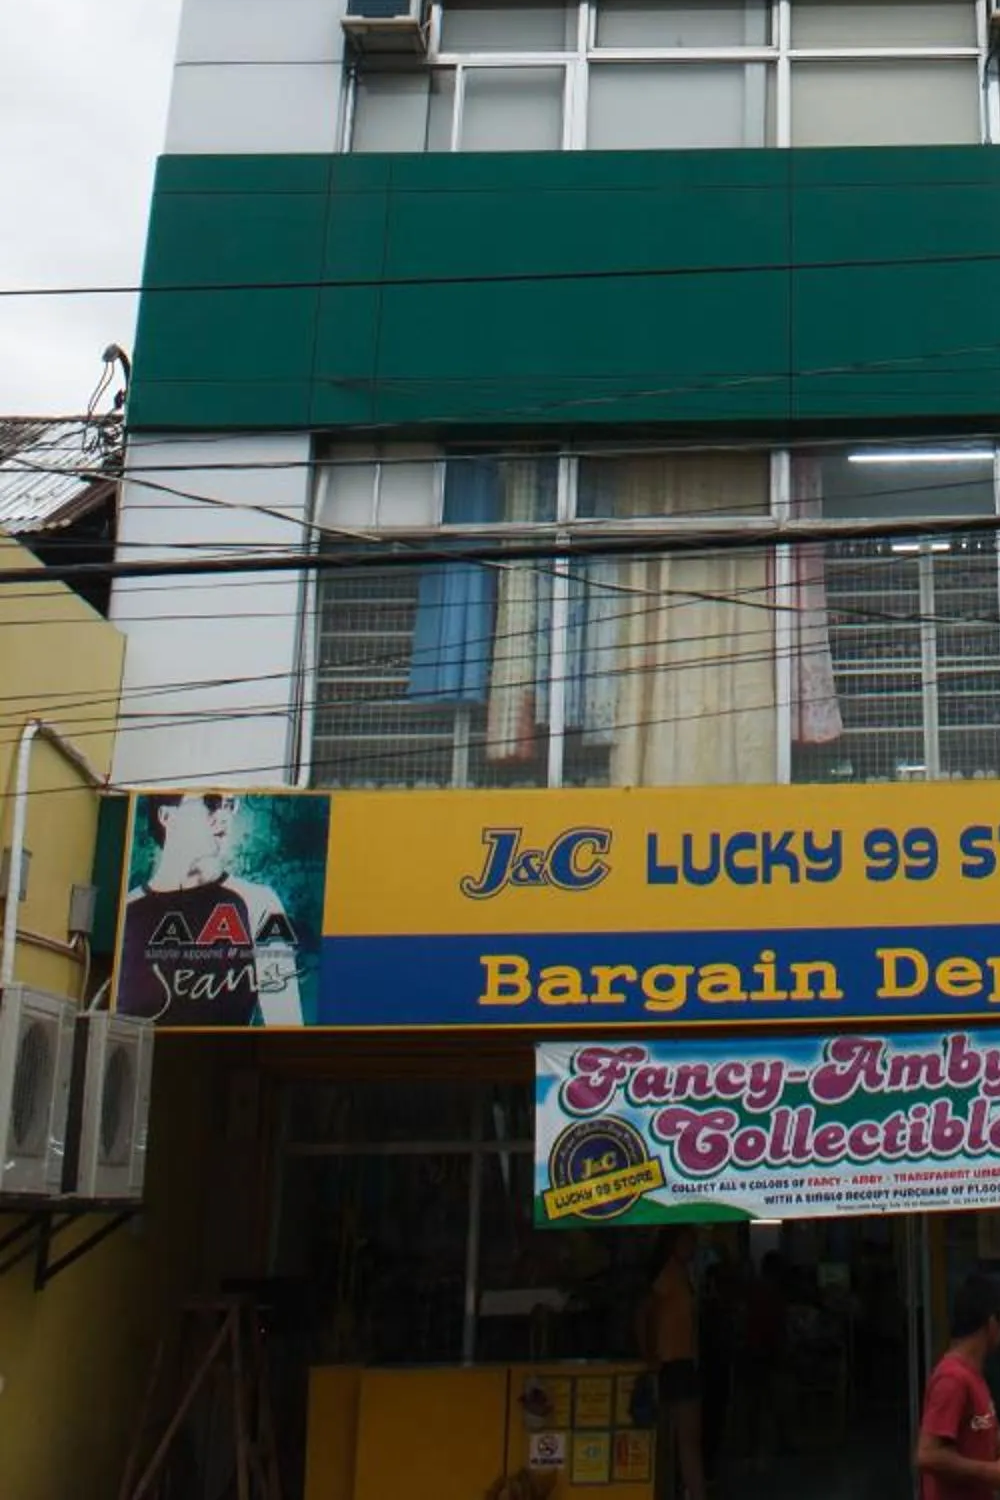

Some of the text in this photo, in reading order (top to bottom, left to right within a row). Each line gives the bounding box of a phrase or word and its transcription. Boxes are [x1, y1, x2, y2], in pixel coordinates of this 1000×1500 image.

[460, 827, 613, 899] J&C
[647, 831, 843, 885] LUCKY
[863, 828, 939, 881] 99
[148, 903, 298, 945] AAA
[478, 950, 843, 1011] Bargain
[555, 1190, 593, 1209] LUCKY
[613, 1170, 653, 1191] STORE
[672, 1182, 716, 1193] COLLECT
[719, 1181, 737, 1191] ALL
[749, 1179, 789, 1190] COLORS
[792, 1179, 804, 1188] OF
[764, 1194, 793, 1204] WITH
[795, 1193, 803, 1203] A
[805, 1191, 842, 1202] SINGLE
[845, 1188, 889, 1200] RECEIPT
[893, 1186, 949, 1198] PURCHASE
[951, 1184, 965, 1195] OF
